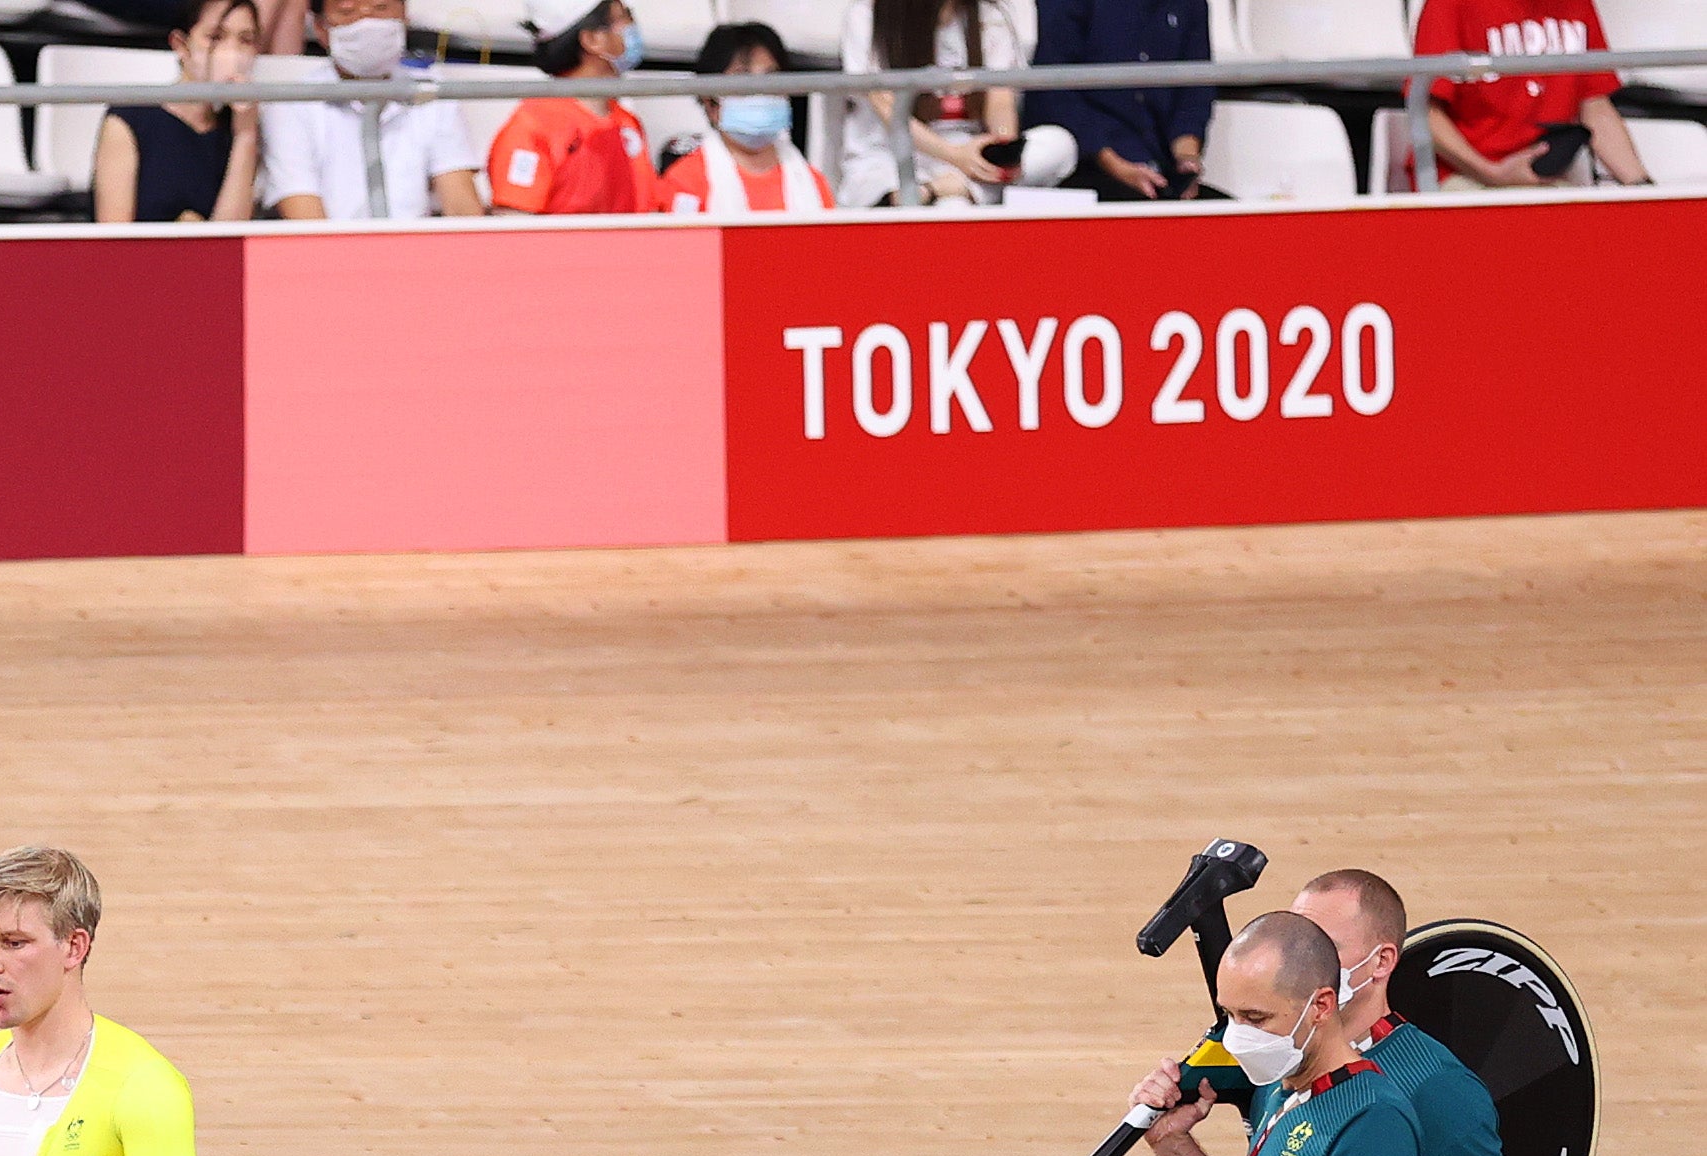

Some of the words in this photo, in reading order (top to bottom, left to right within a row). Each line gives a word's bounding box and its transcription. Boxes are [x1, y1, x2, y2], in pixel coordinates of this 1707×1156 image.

[783, 314, 1123, 440] TOKYO
[1150, 302, 1394, 424] 2020
[1427, 948, 1580, 1065] ZIPP
